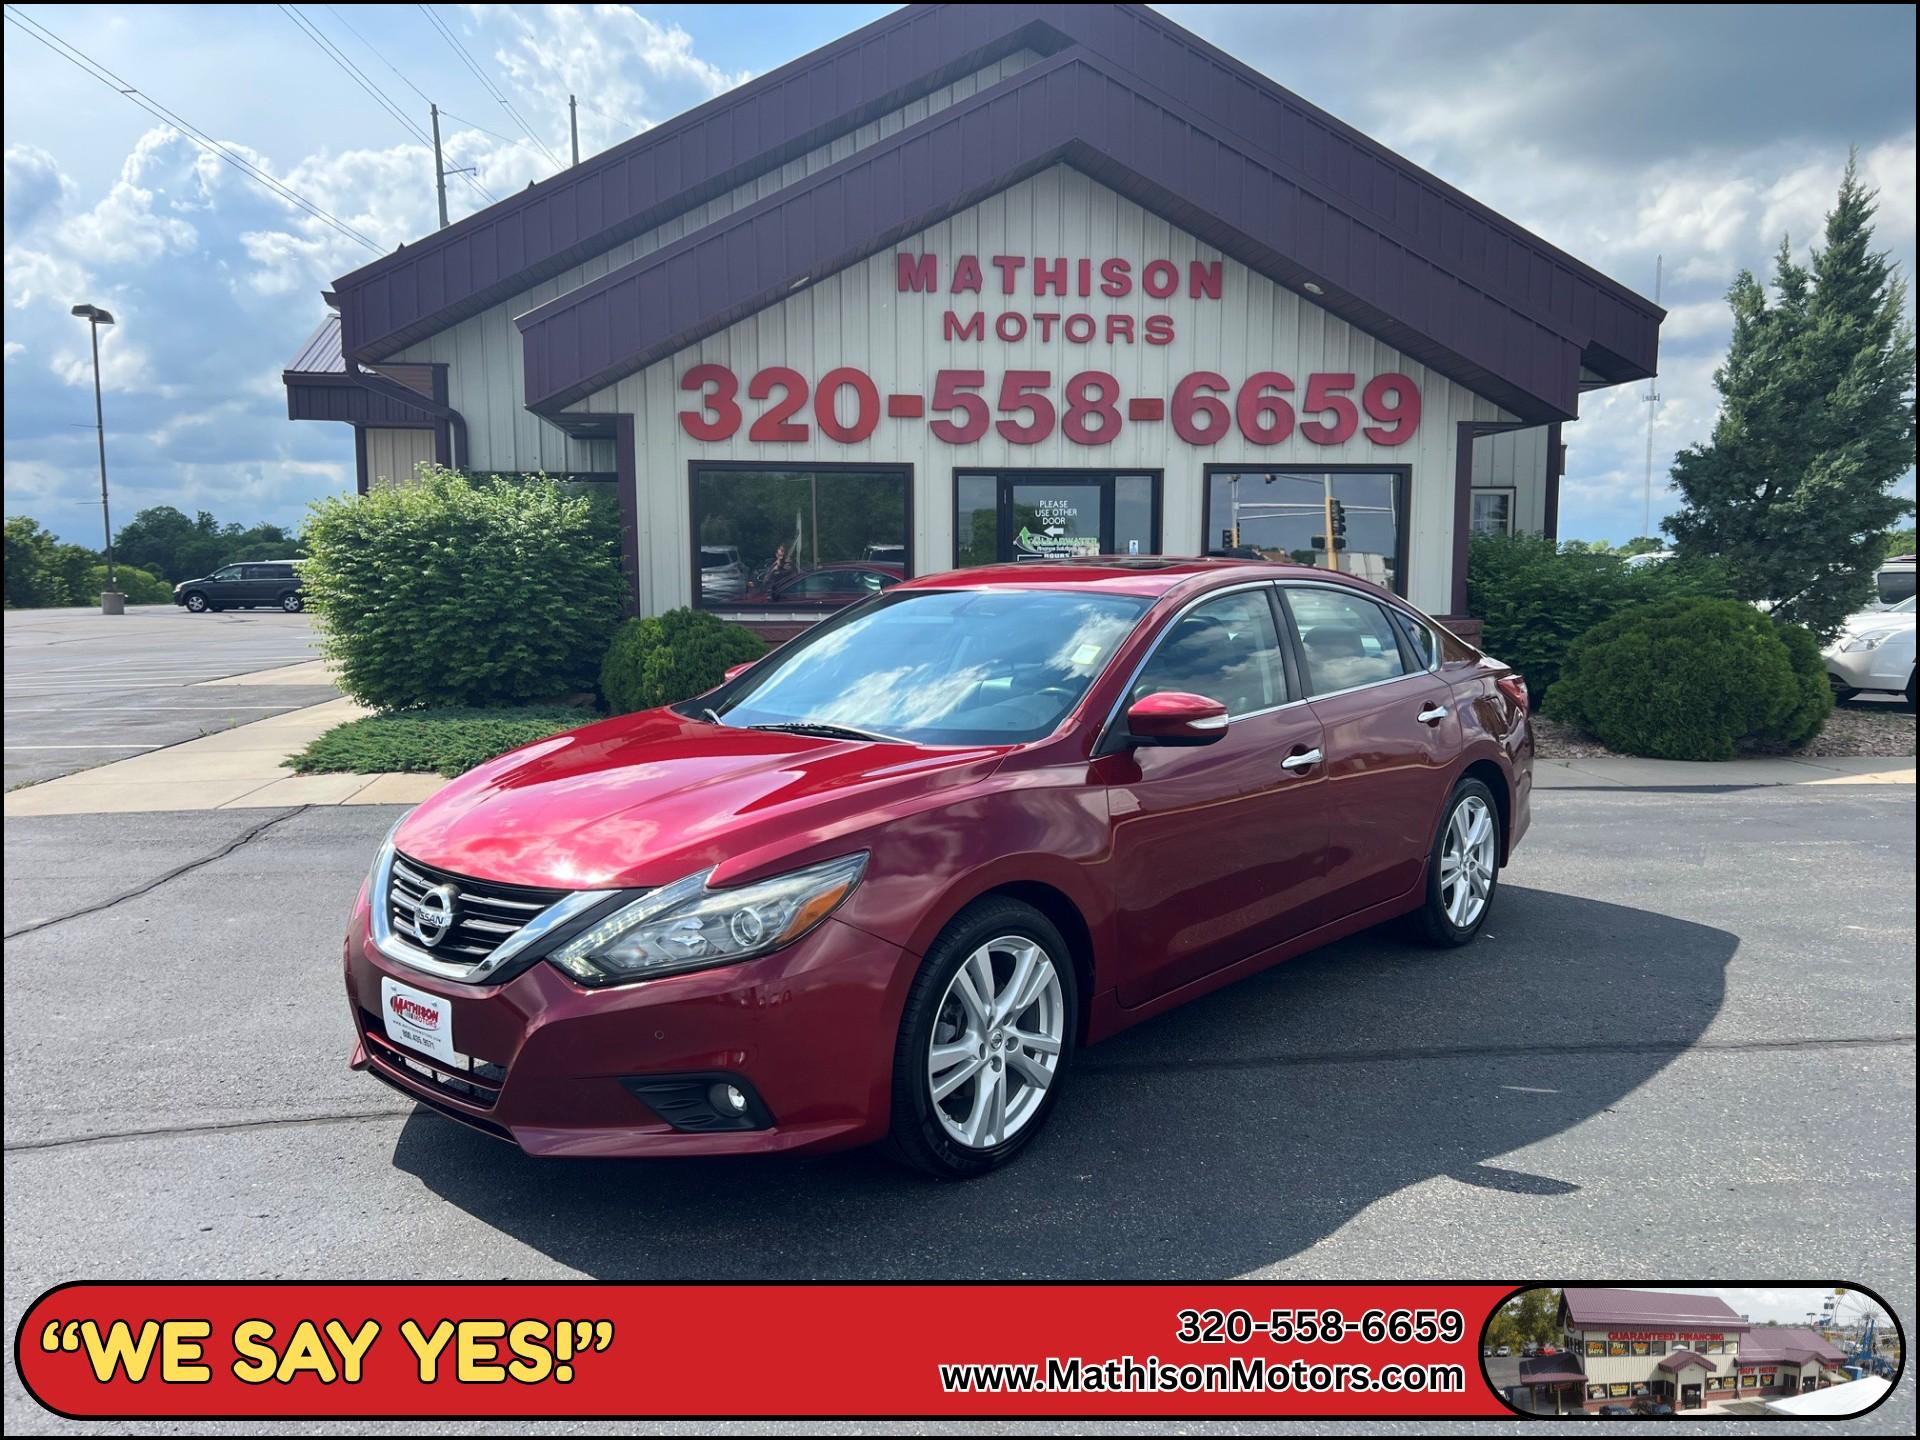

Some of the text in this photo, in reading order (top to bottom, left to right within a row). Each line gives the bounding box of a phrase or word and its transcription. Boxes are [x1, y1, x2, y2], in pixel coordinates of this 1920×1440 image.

[897, 253, 1223, 299] MATHISON
[943, 311, 1175, 345] MOTORS
[680, 364, 1421, 446] 320-558-6659
[1039, 500, 1069, 508] PLEASE
[1035, 508, 1078, 517] USE OTHER
[1042, 517, 1066, 525] DOOR
[1608, 1331, 1724, 1341] GUARANTEED FINANCING
